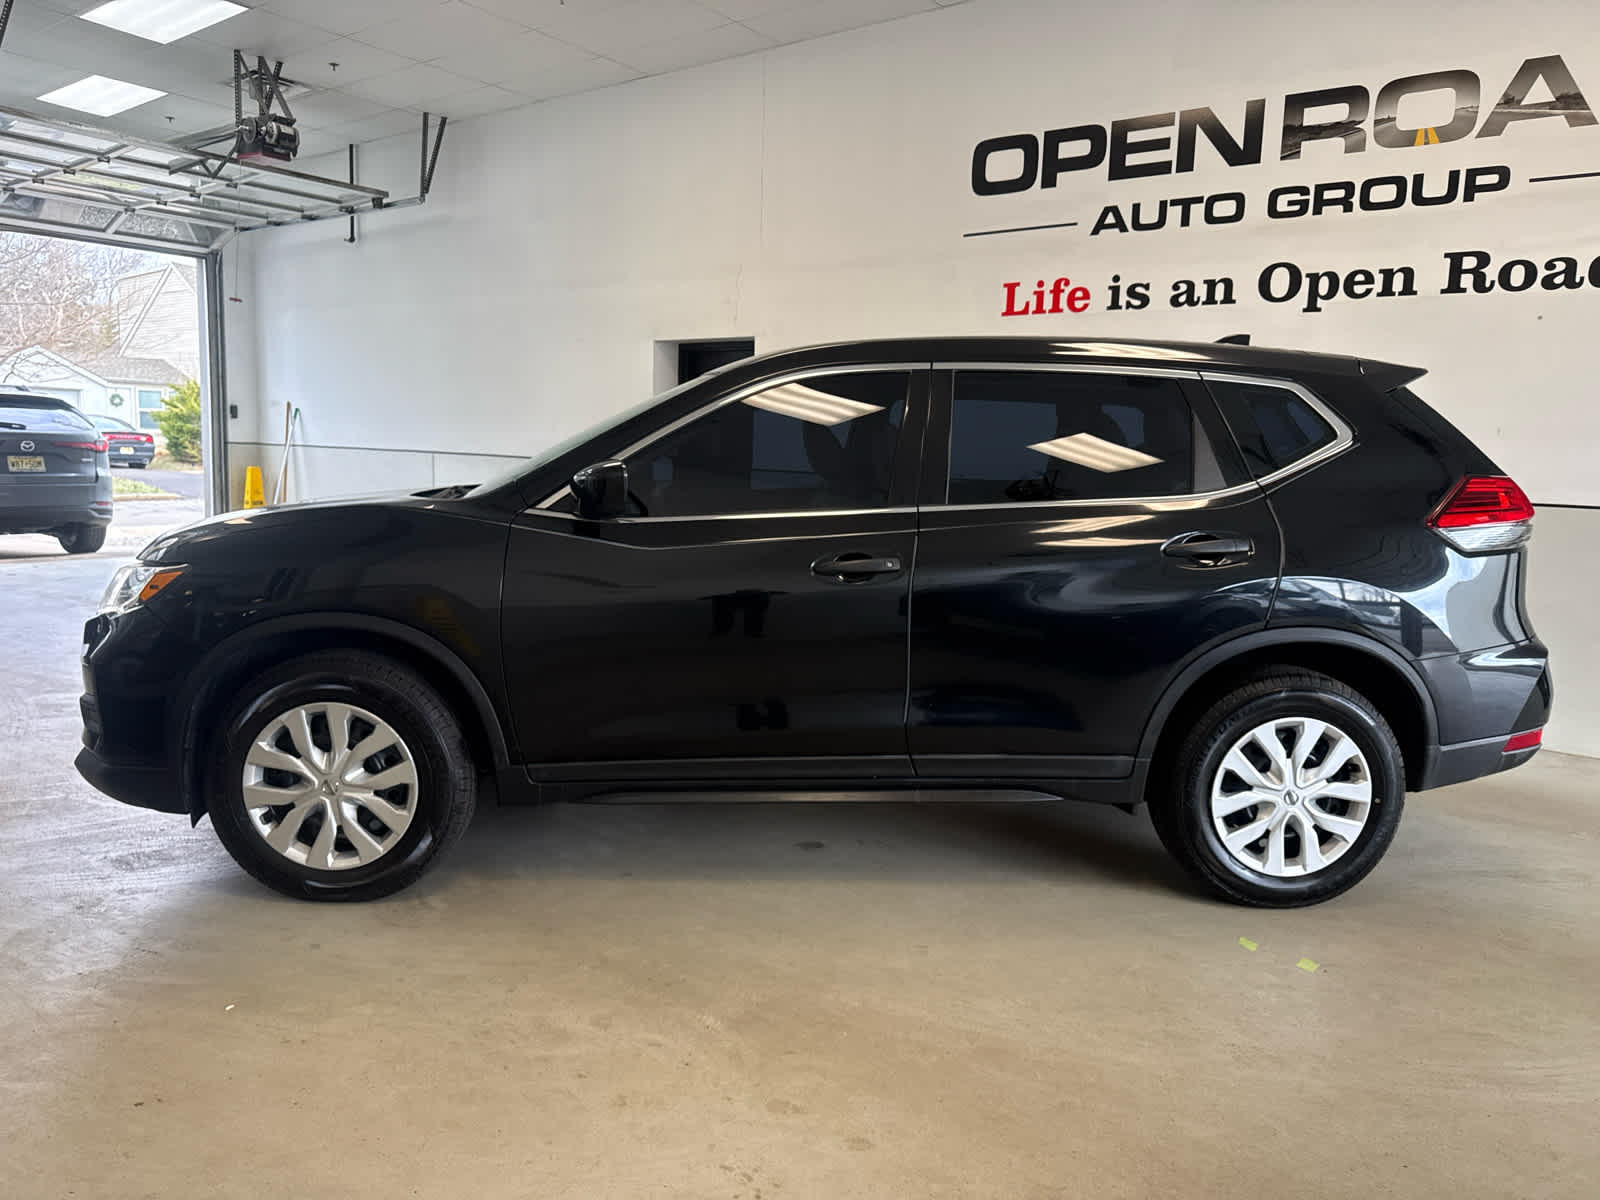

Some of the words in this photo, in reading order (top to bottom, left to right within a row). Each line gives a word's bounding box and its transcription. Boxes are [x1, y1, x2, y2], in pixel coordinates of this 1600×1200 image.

[972, 99, 1266, 197] OPEN
[1090, 192, 1246, 236] AUTO
[1267, 166, 1511, 219] GROUP
[1001, 277, 1091, 316] Life
[1106, 275, 1151, 311] is
[1169, 278, 1237, 308] an
[1258, 262, 1417, 313] Open
[1440, 250, 1600, 295] Roa
